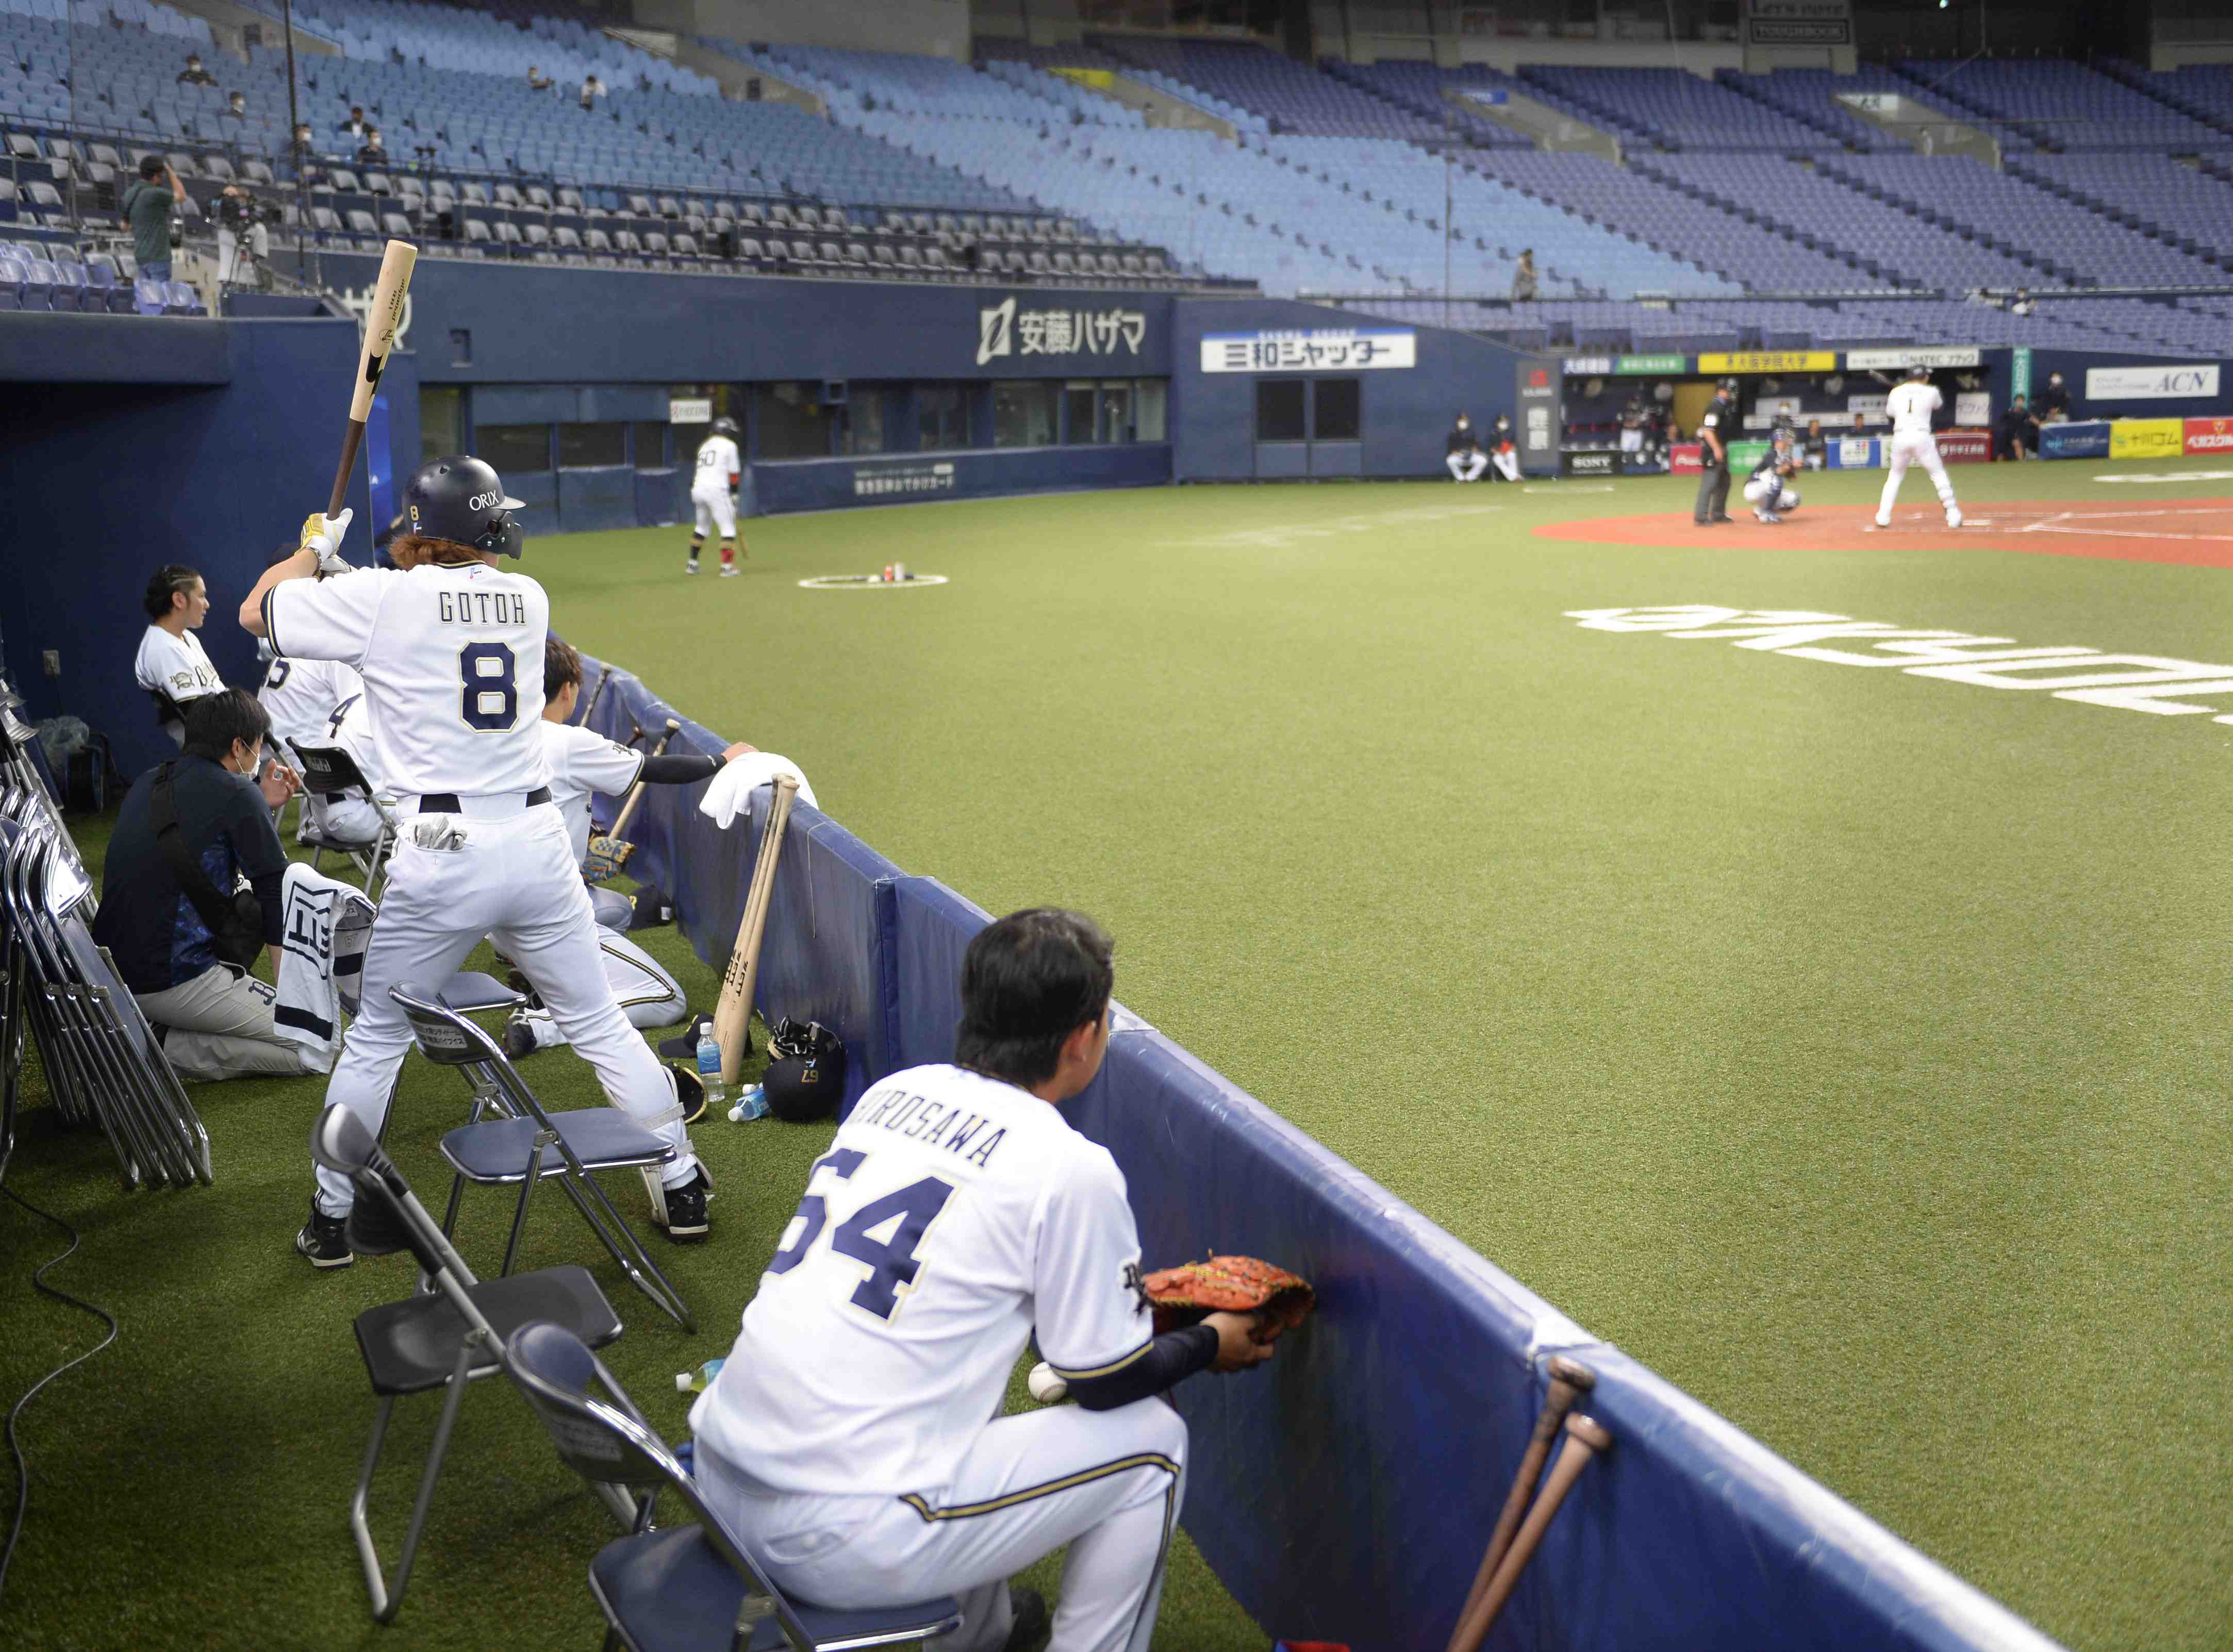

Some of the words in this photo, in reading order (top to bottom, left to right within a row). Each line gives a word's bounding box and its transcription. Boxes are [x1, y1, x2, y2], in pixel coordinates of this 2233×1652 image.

[1018, 311, 1146, 355] 安藤ハザマ
[1226, 340, 1391, 367] 三和シャッター
[2155, 371, 2208, 393] ACN
[2128, 432, 2179, 446] 十川ゴム
[470, 490, 499, 511] ORIX
[438, 591, 526, 625] GOTOH
[457, 640, 520, 734] 8
